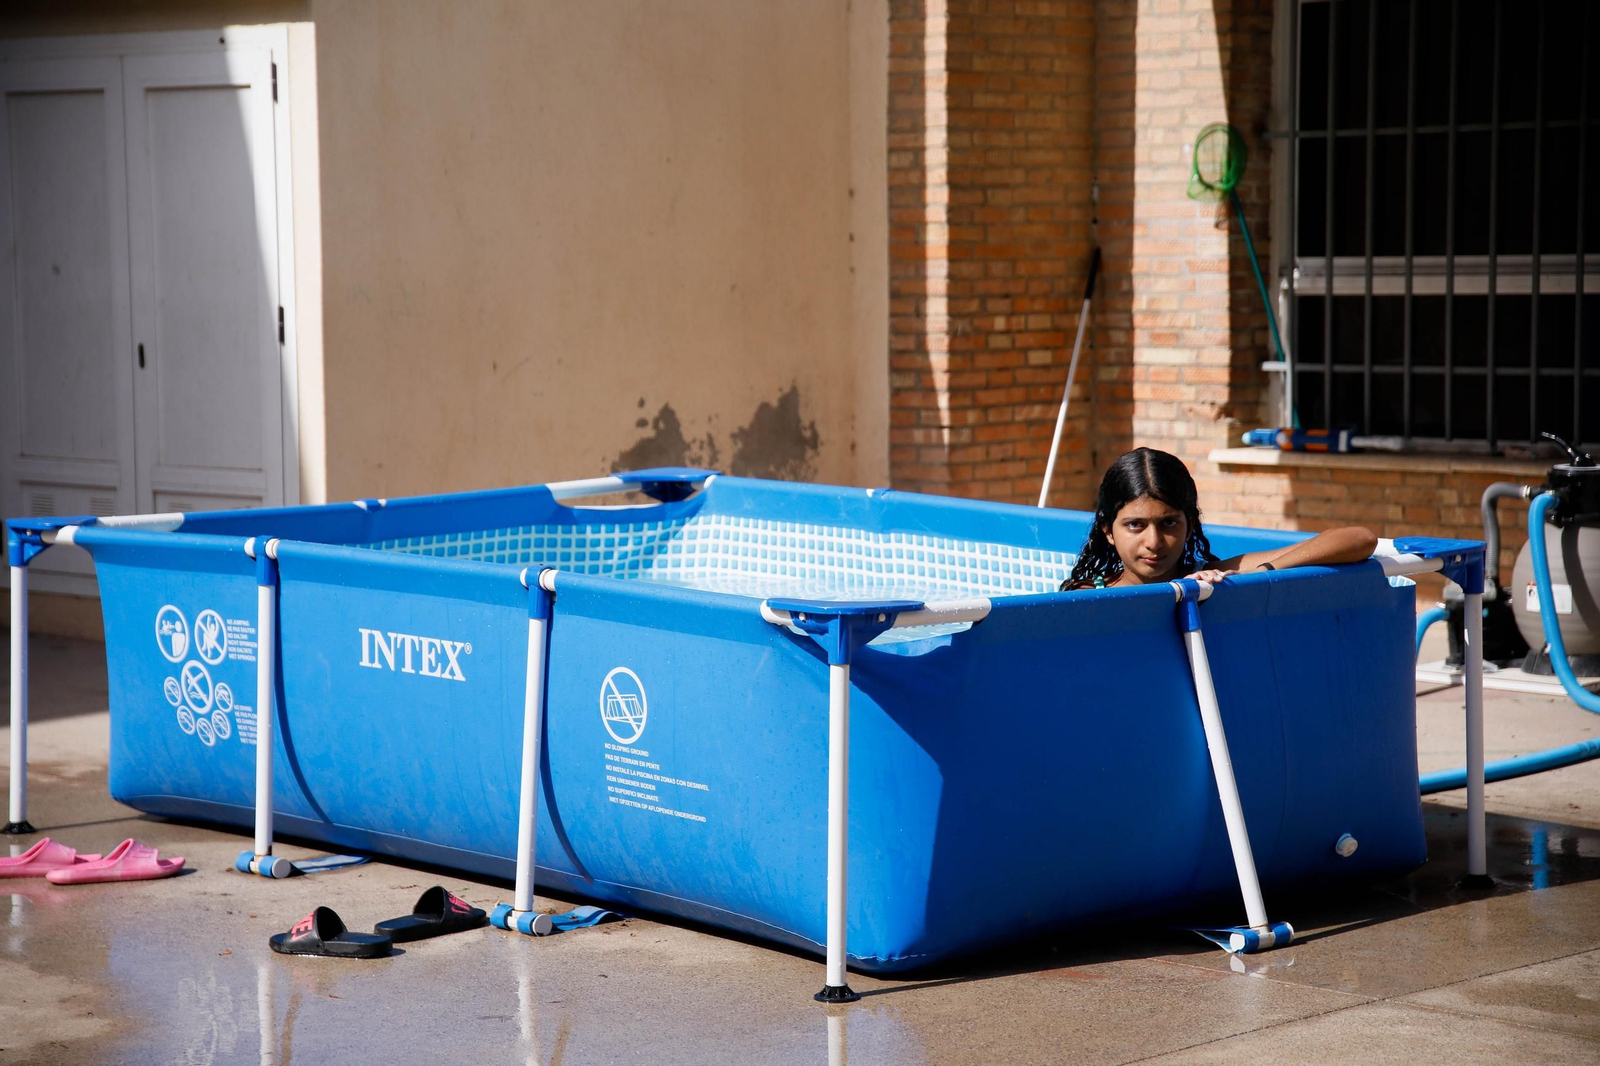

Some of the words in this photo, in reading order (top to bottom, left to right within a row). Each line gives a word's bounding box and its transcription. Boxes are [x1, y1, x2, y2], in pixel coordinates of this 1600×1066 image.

[612, 744, 629, 754] SLOPING
[630, 748, 649, 757] GROUND
[605, 753, 613, 761] PAS
[621, 756, 638, 766] TERRAIN
[646, 761, 660, 771] PENTE
[606, 775, 616, 783] KEIN
[641, 781, 656, 791] BODEN
[637, 771, 653, 780] PISCINA
[661, 775, 675, 785] ZONAS
[676, 779, 686, 787] CON
[687, 781, 709, 791] DESNIVEL
[609, 796, 618, 804] NIET
